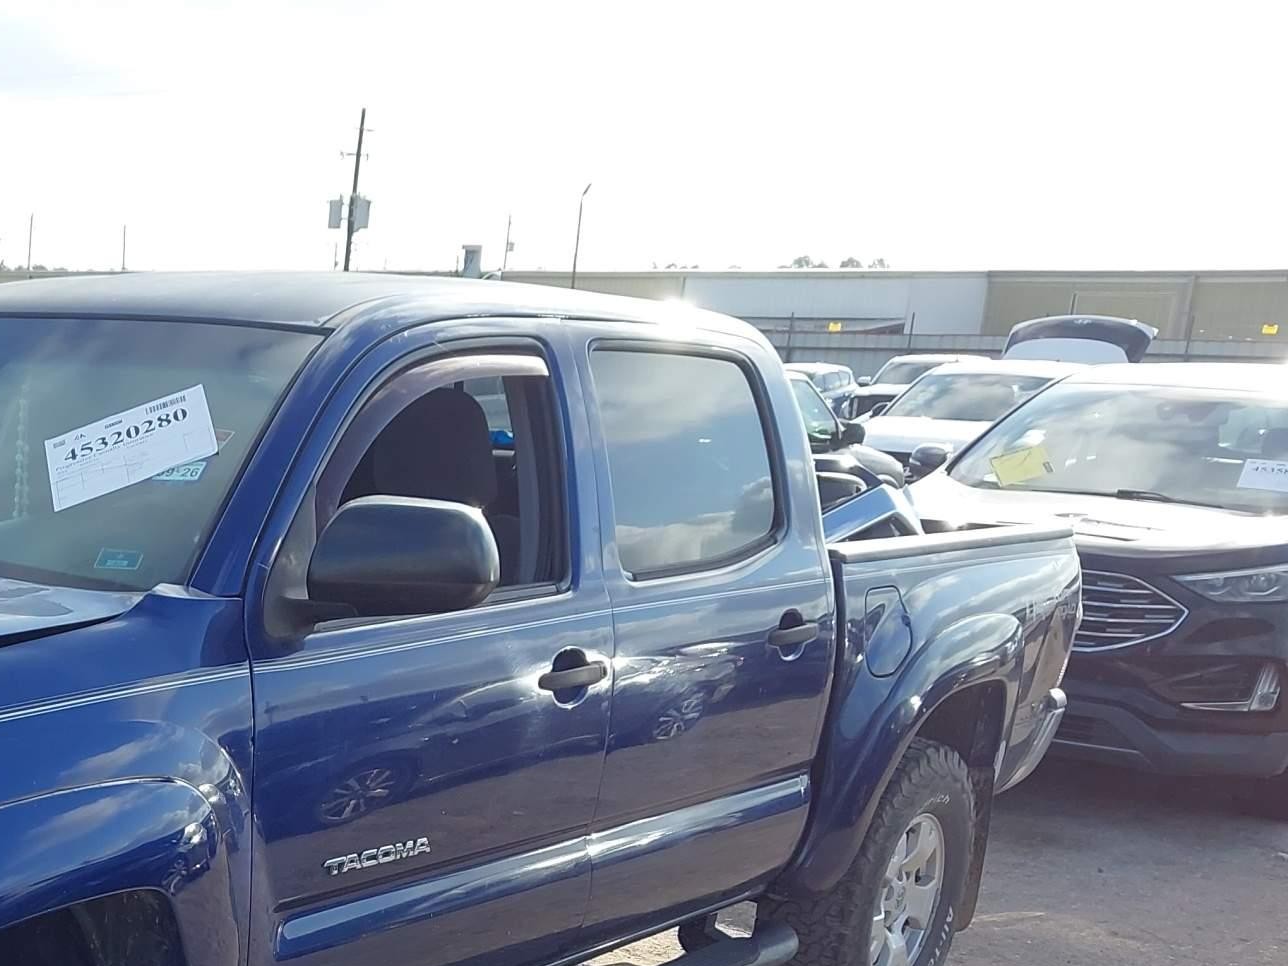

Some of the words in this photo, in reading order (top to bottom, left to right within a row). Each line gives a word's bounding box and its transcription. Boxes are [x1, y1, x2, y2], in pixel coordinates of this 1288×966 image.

[64, 408, 188, 461] 45320280
[181, 467, 201, 478] 26
[323, 837, 431, 876] TACOMA
